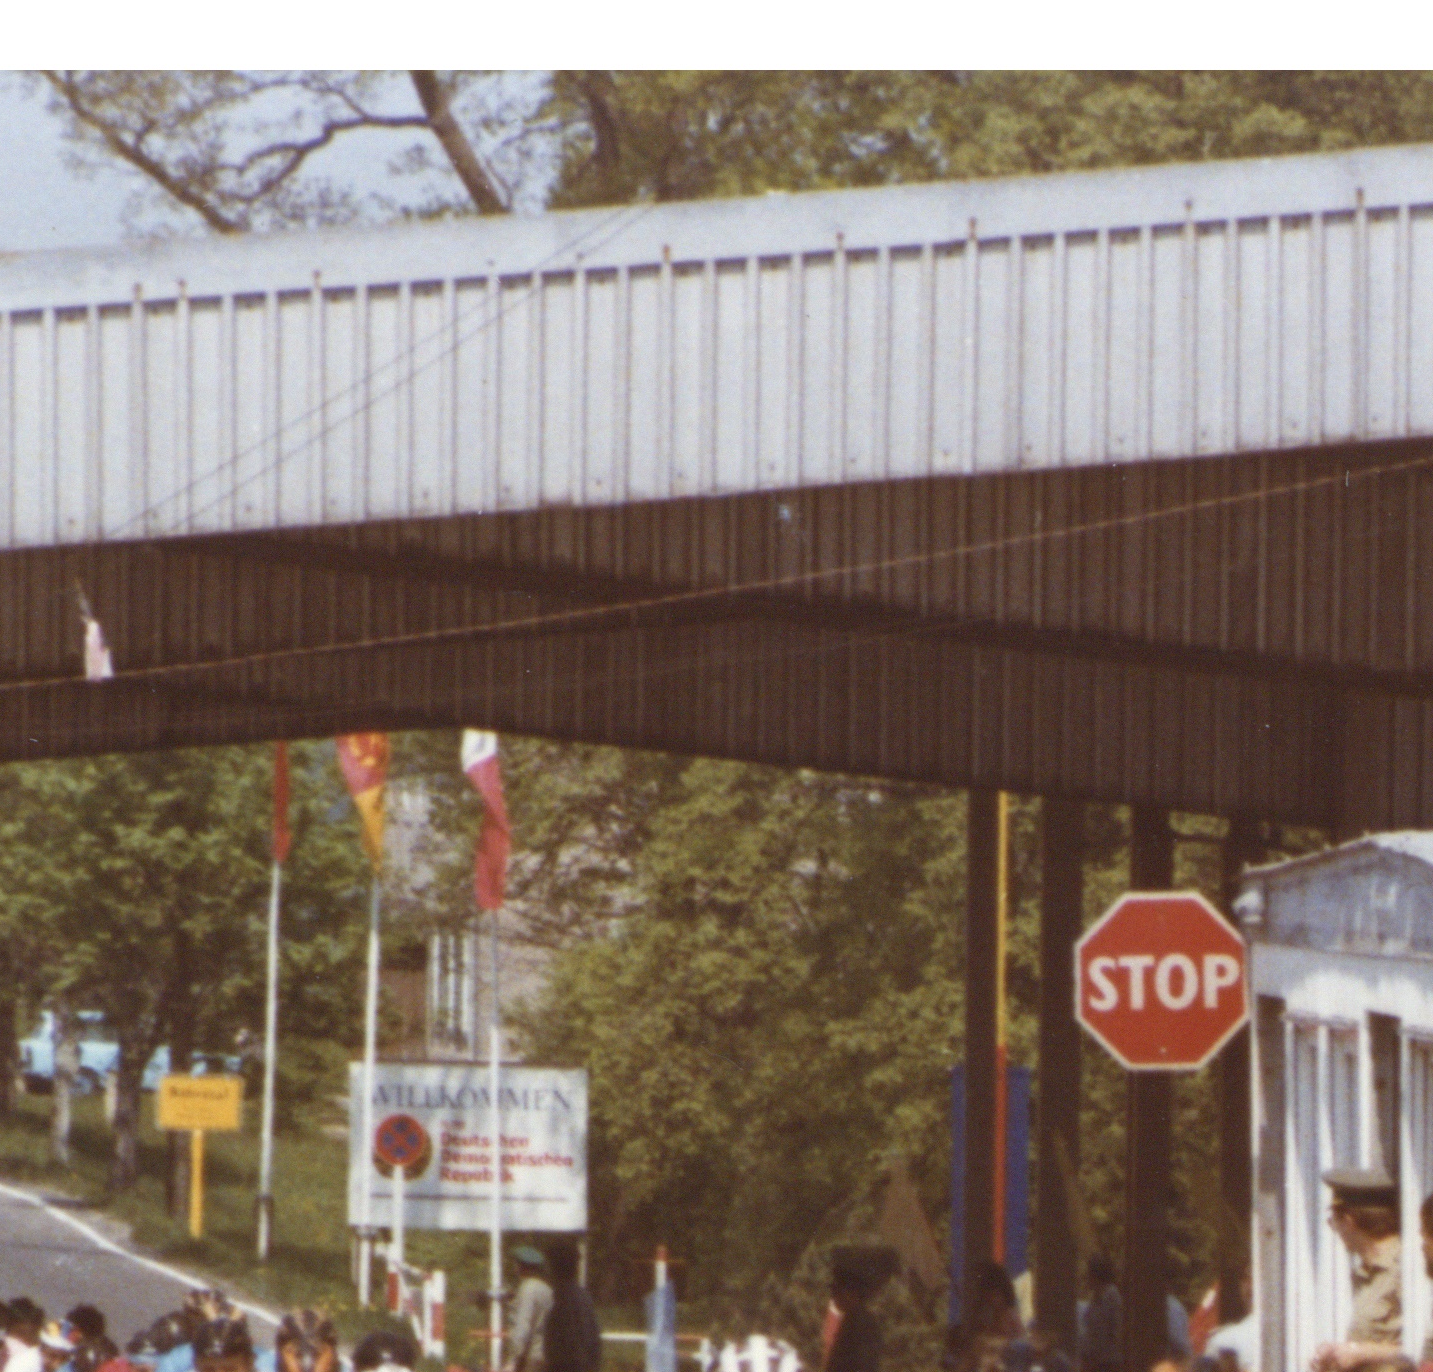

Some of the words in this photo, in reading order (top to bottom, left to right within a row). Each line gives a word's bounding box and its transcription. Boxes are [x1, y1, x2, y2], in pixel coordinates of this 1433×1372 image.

[1087, 953, 1240, 1011] STOP
[440, 1132, 529, 1148] Deutshen
[440, 1149, 574, 1167] Demoratischen
